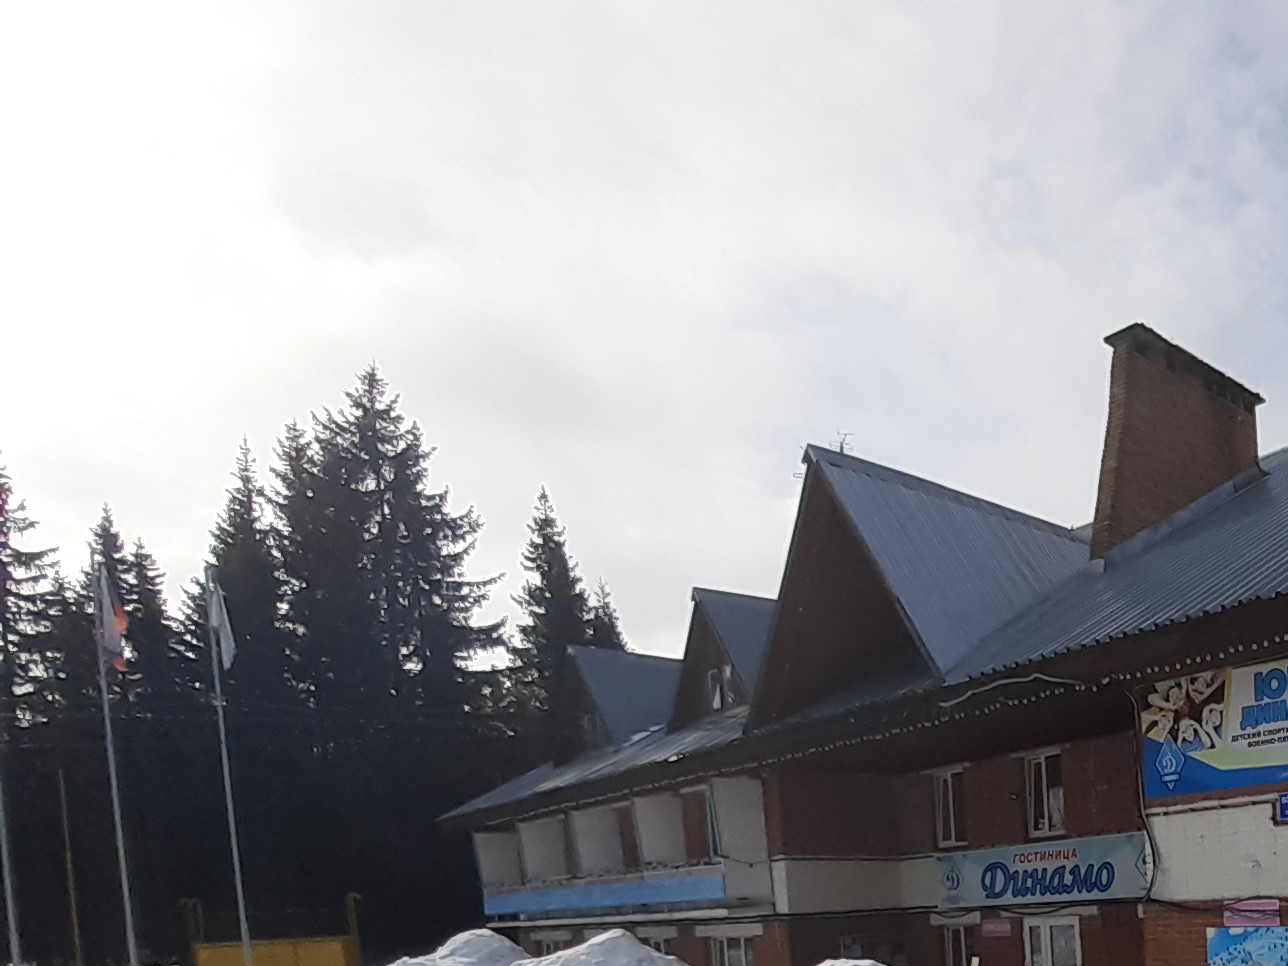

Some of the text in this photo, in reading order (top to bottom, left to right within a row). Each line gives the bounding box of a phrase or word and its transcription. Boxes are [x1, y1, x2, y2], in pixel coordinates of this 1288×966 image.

[1231, 729, 1262, 743] ДЕТСКИЙ
[1013, 848, 1078, 864] ГОСТИНИЦА
[981, 860, 1116, 899] Динамо
